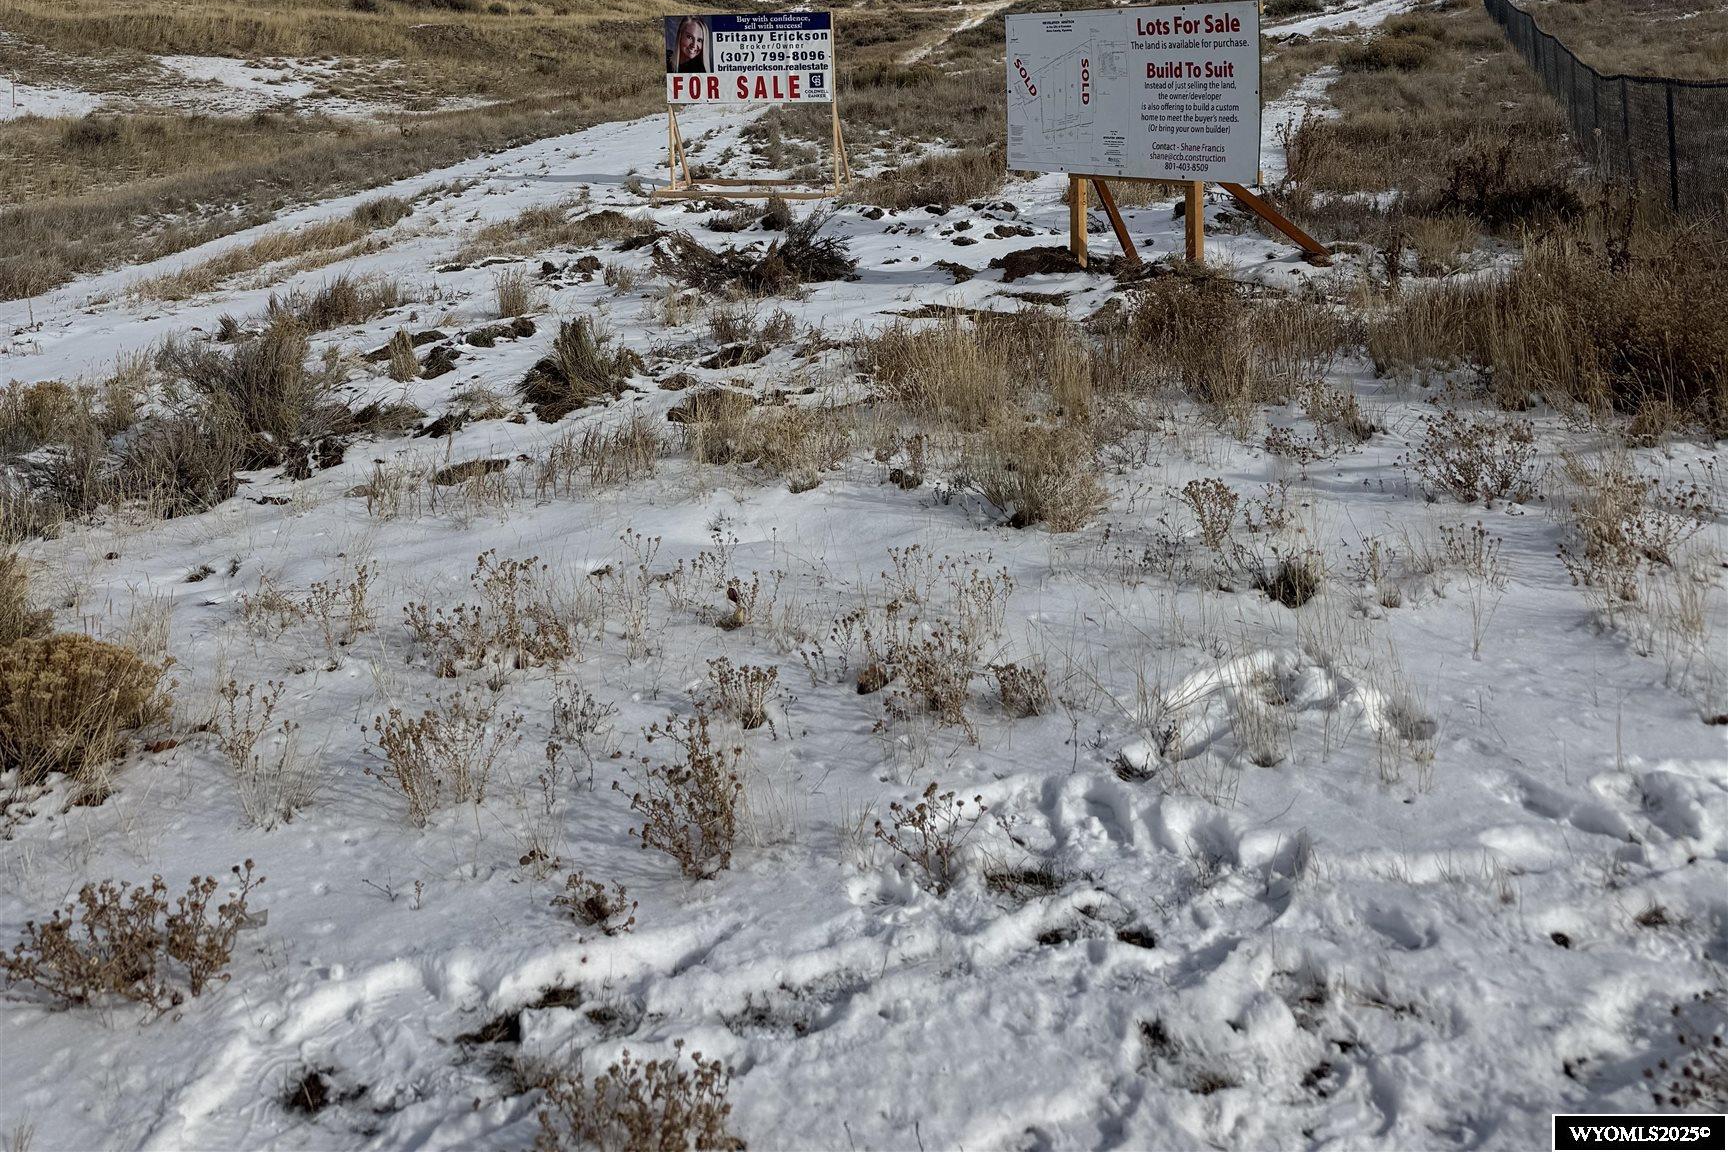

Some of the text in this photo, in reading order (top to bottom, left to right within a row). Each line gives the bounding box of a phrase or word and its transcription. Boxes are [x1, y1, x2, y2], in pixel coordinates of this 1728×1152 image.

[1137, 13, 1240, 35] Lots For Sale
[716, 32, 828, 43] Britany Erickson
[1131, 38, 1249, 49] The land is available for purchase.
[720, 51, 824, 62] (307) 799-8096
[718, 63, 828, 72] britanyerickson.realestate
[1147, 61, 1234, 78] Build To Suit
[1014, 58, 1038, 96] SOLD
[1081, 58, 1090, 105] SOLD
[673, 75, 801, 100] FOR SALE
[1175, 82, 1186, 90] just
[1187, 81, 1208, 91] selling
[1220, 81, 1236, 90] land,
[1169, 92, 1222, 101] owner/developer
[1161, 103, 1184, 112] offering
[1193, 103, 1209, 111] build
[1219, 114, 1239, 122] needs.
[1148, 124, 1158, 132] (Or
[1159, 124, 1174, 134] bring
[1206, 125, 1230, 134] builder)
[1152, 142, 1176, 151] Contact
[1181, 142, 1200, 152] Shane
[1201, 144, 1225, 152] Francis
[1150, 152, 1226, 162] shane@ccb.construction
[1165, 162, 1209, 171] 801-403-8509
